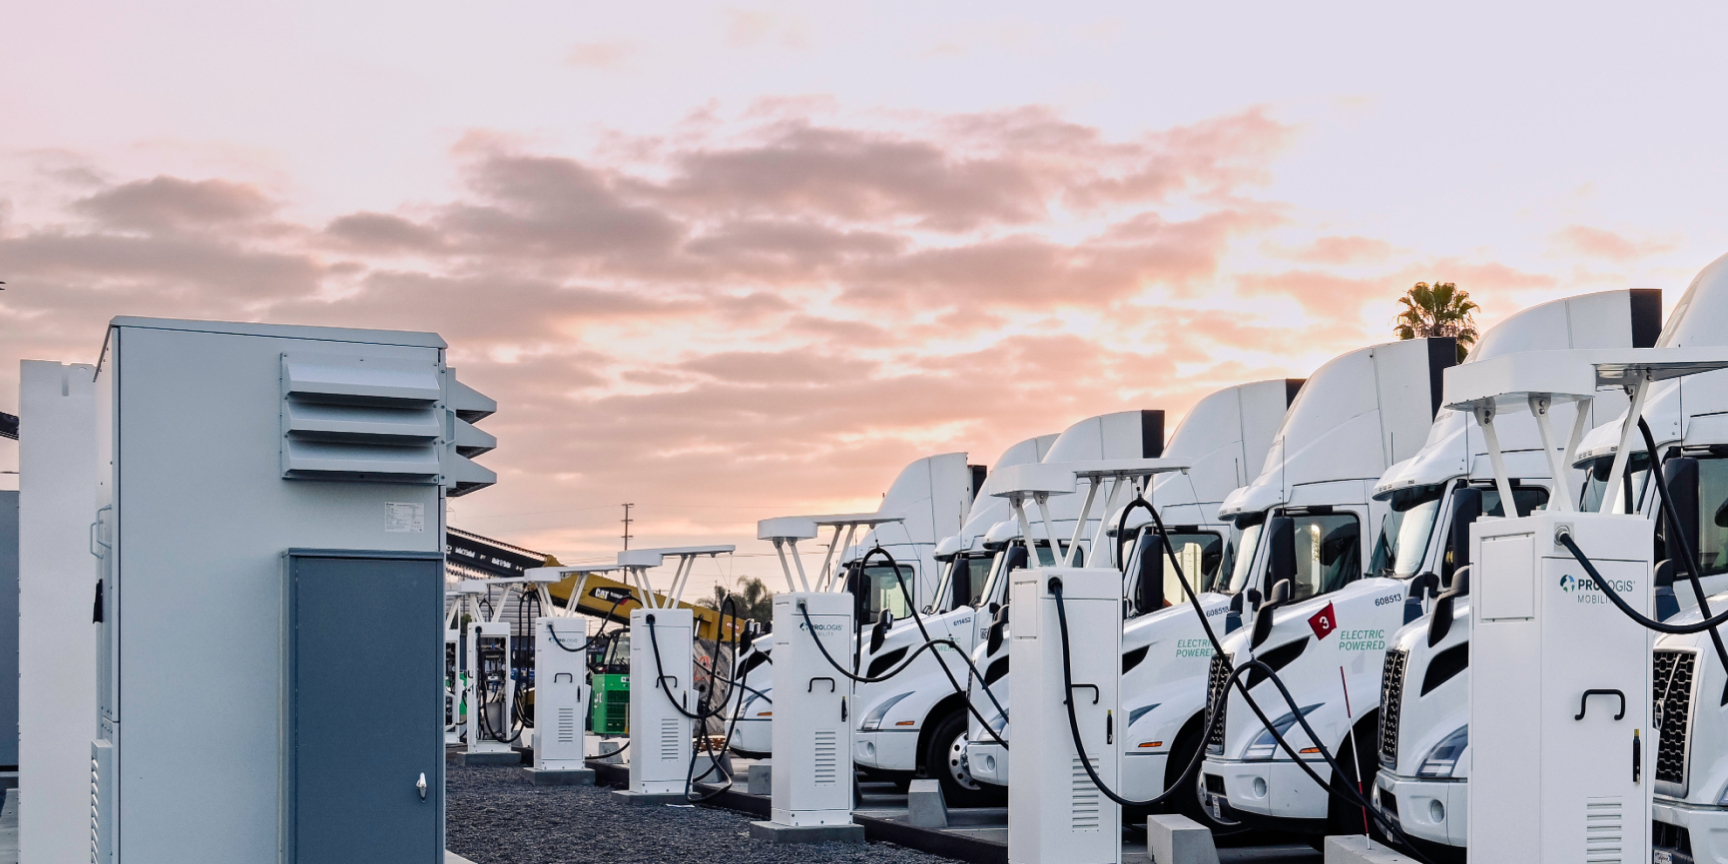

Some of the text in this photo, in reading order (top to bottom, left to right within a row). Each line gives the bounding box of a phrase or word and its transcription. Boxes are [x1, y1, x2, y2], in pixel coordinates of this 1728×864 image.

[1578, 578, 1633, 592] PROOGIS
[594, 588, 609, 600] CAT
[1375, 594, 1402, 607] 608513
[1319, 616, 1330, 630] 3
[1340, 629, 1385, 640] ELECTRIC
[1339, 641, 1386, 651] POWERED
